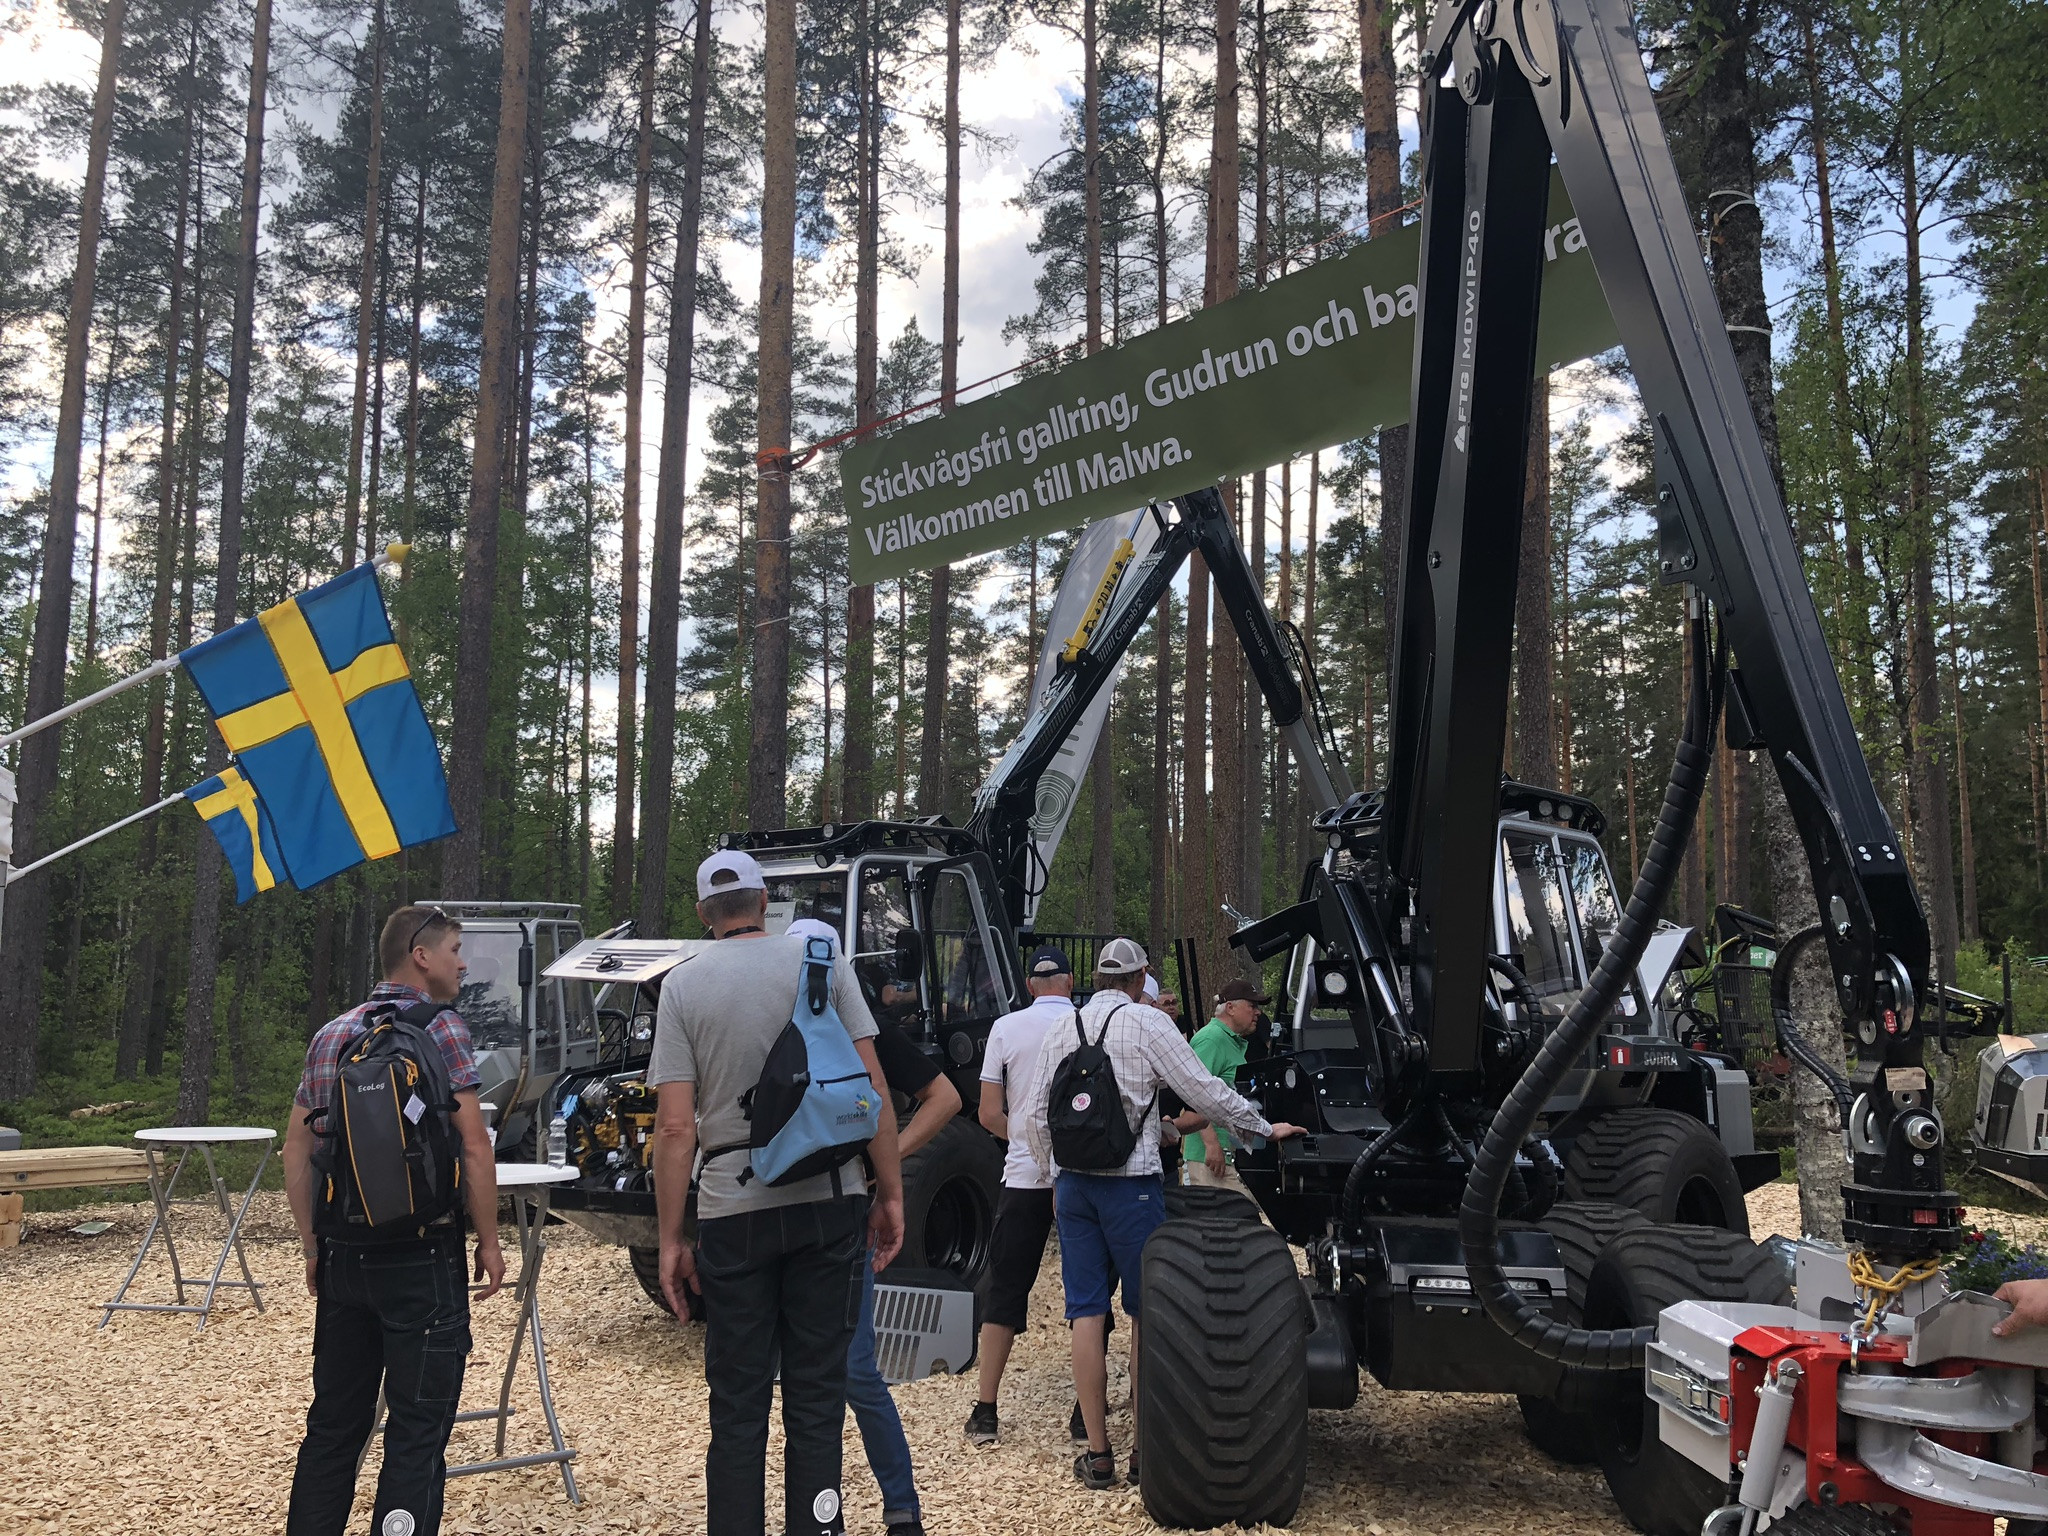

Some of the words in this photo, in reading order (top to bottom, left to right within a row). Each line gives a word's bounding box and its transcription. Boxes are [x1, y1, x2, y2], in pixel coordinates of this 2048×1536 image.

[860, 427, 1012, 508] Stickvägsfri
[1016, 391, 1140, 464] gallring,
[1144, 336, 1279, 408] Gudrun
[1286, 300, 1358, 358] och
[1457, 371, 1471, 423] FTG
[864, 487, 1030, 556] Välkommen
[1033, 463, 1073, 507] till
[1077, 437, 1193, 489] Malwa.
[1115, 606, 1139, 640] Cranab
[1245, 609, 1266, 647] Cranab
[358, 1083, 385, 1093] EcoLog
